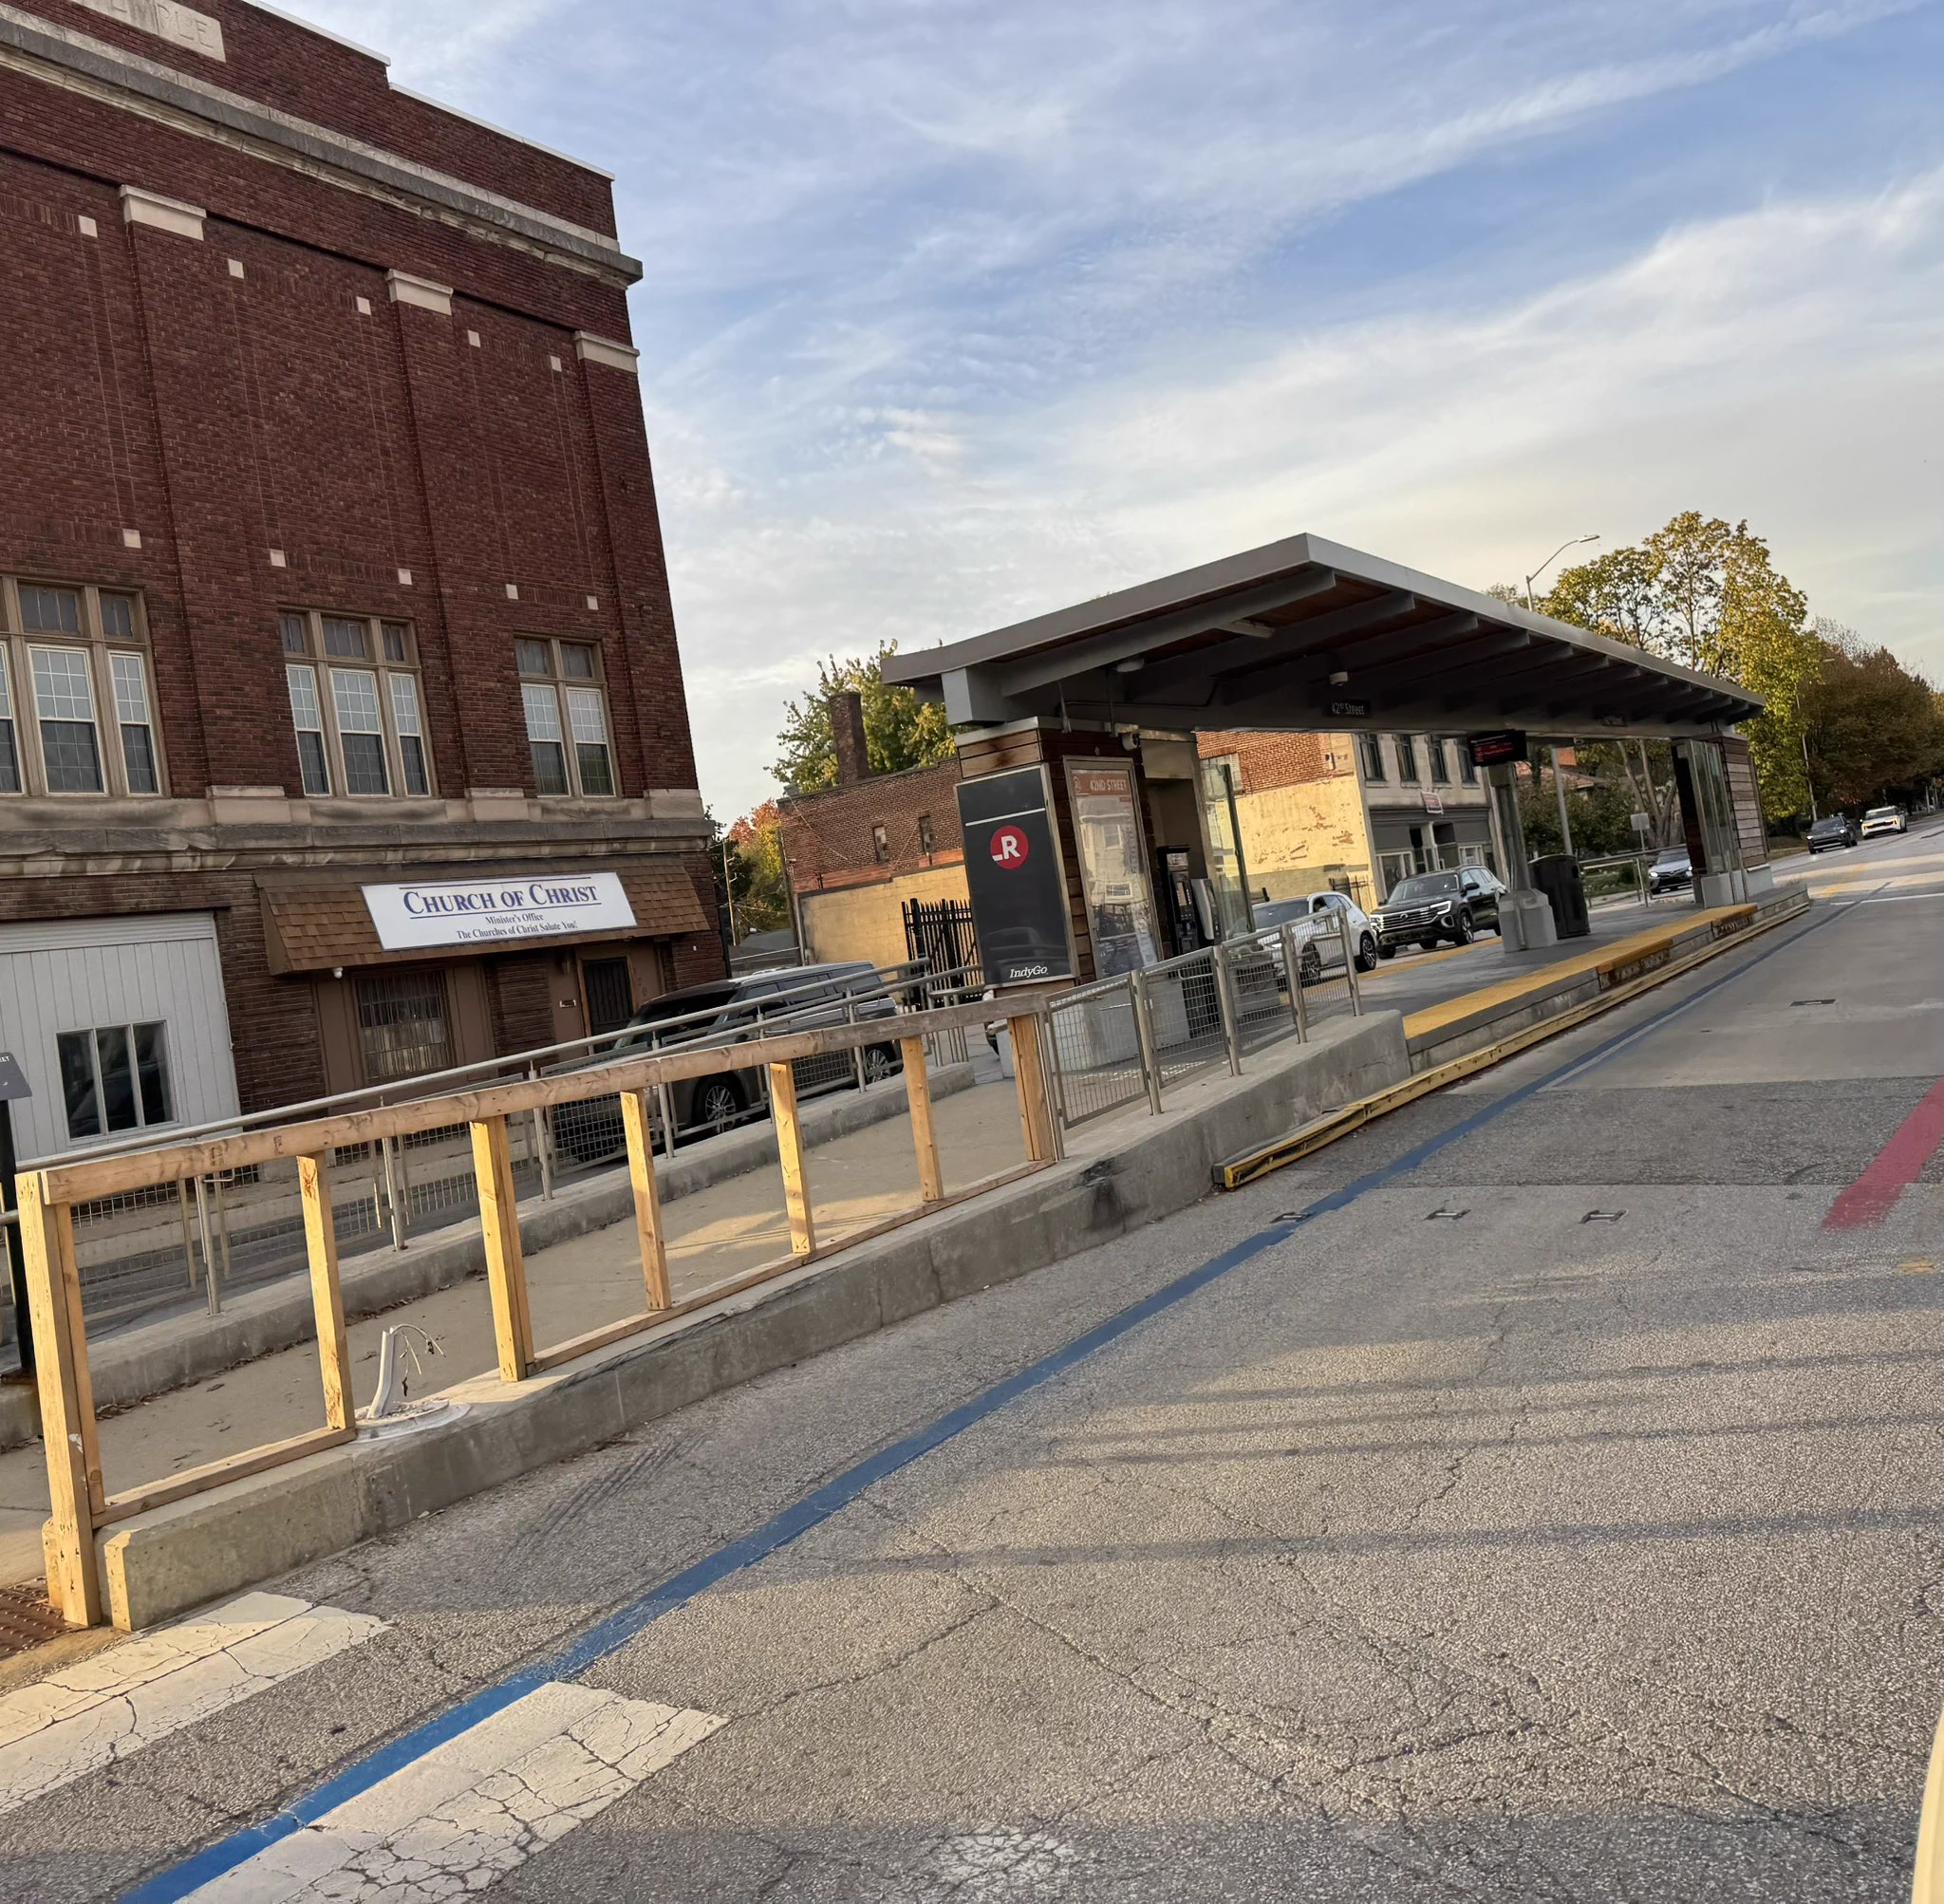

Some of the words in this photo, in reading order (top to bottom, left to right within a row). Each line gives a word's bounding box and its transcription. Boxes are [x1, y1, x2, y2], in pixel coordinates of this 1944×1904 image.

[1107, 778, 1127, 792] STREET
[403, 890, 497, 915] CHURCH
[500, 890, 524, 908] OF
[529, 884, 598, 905] CHRIST
[485, 913, 521, 925] Minister's
[521, 912, 544, 923] Office
[456, 929, 472, 940] The
[472, 926, 508, 939] Churches
[508, 925, 516, 935] of
[515, 924, 539, 935] Christ
[539, 922, 560, 932] Salute
[561, 920, 578, 929] You!
[1009, 965, 1047, 979] IndyGo
